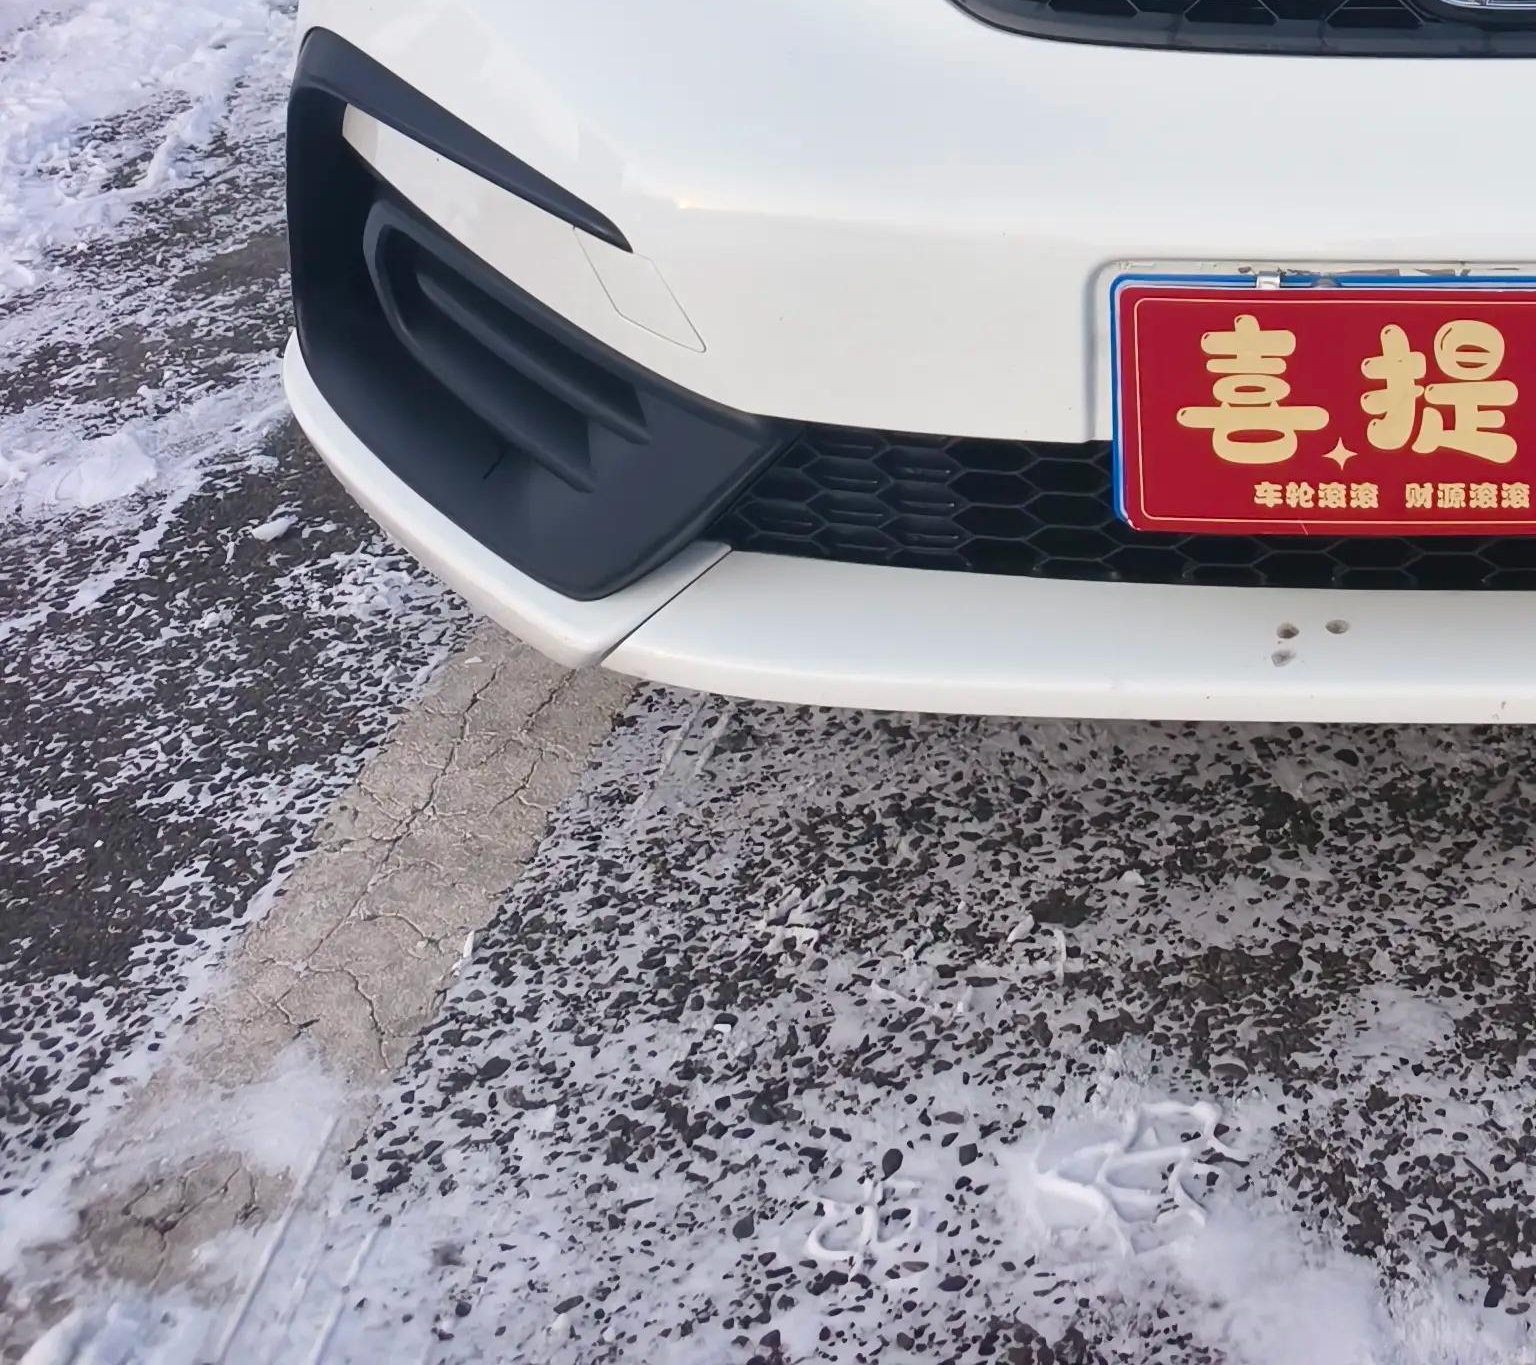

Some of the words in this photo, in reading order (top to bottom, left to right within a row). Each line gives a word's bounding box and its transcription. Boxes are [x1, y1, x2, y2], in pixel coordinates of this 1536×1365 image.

[1253, 481, 1379, 509] 车轮滚滚
[1405, 482, 1530, 509] 财源滚滚
